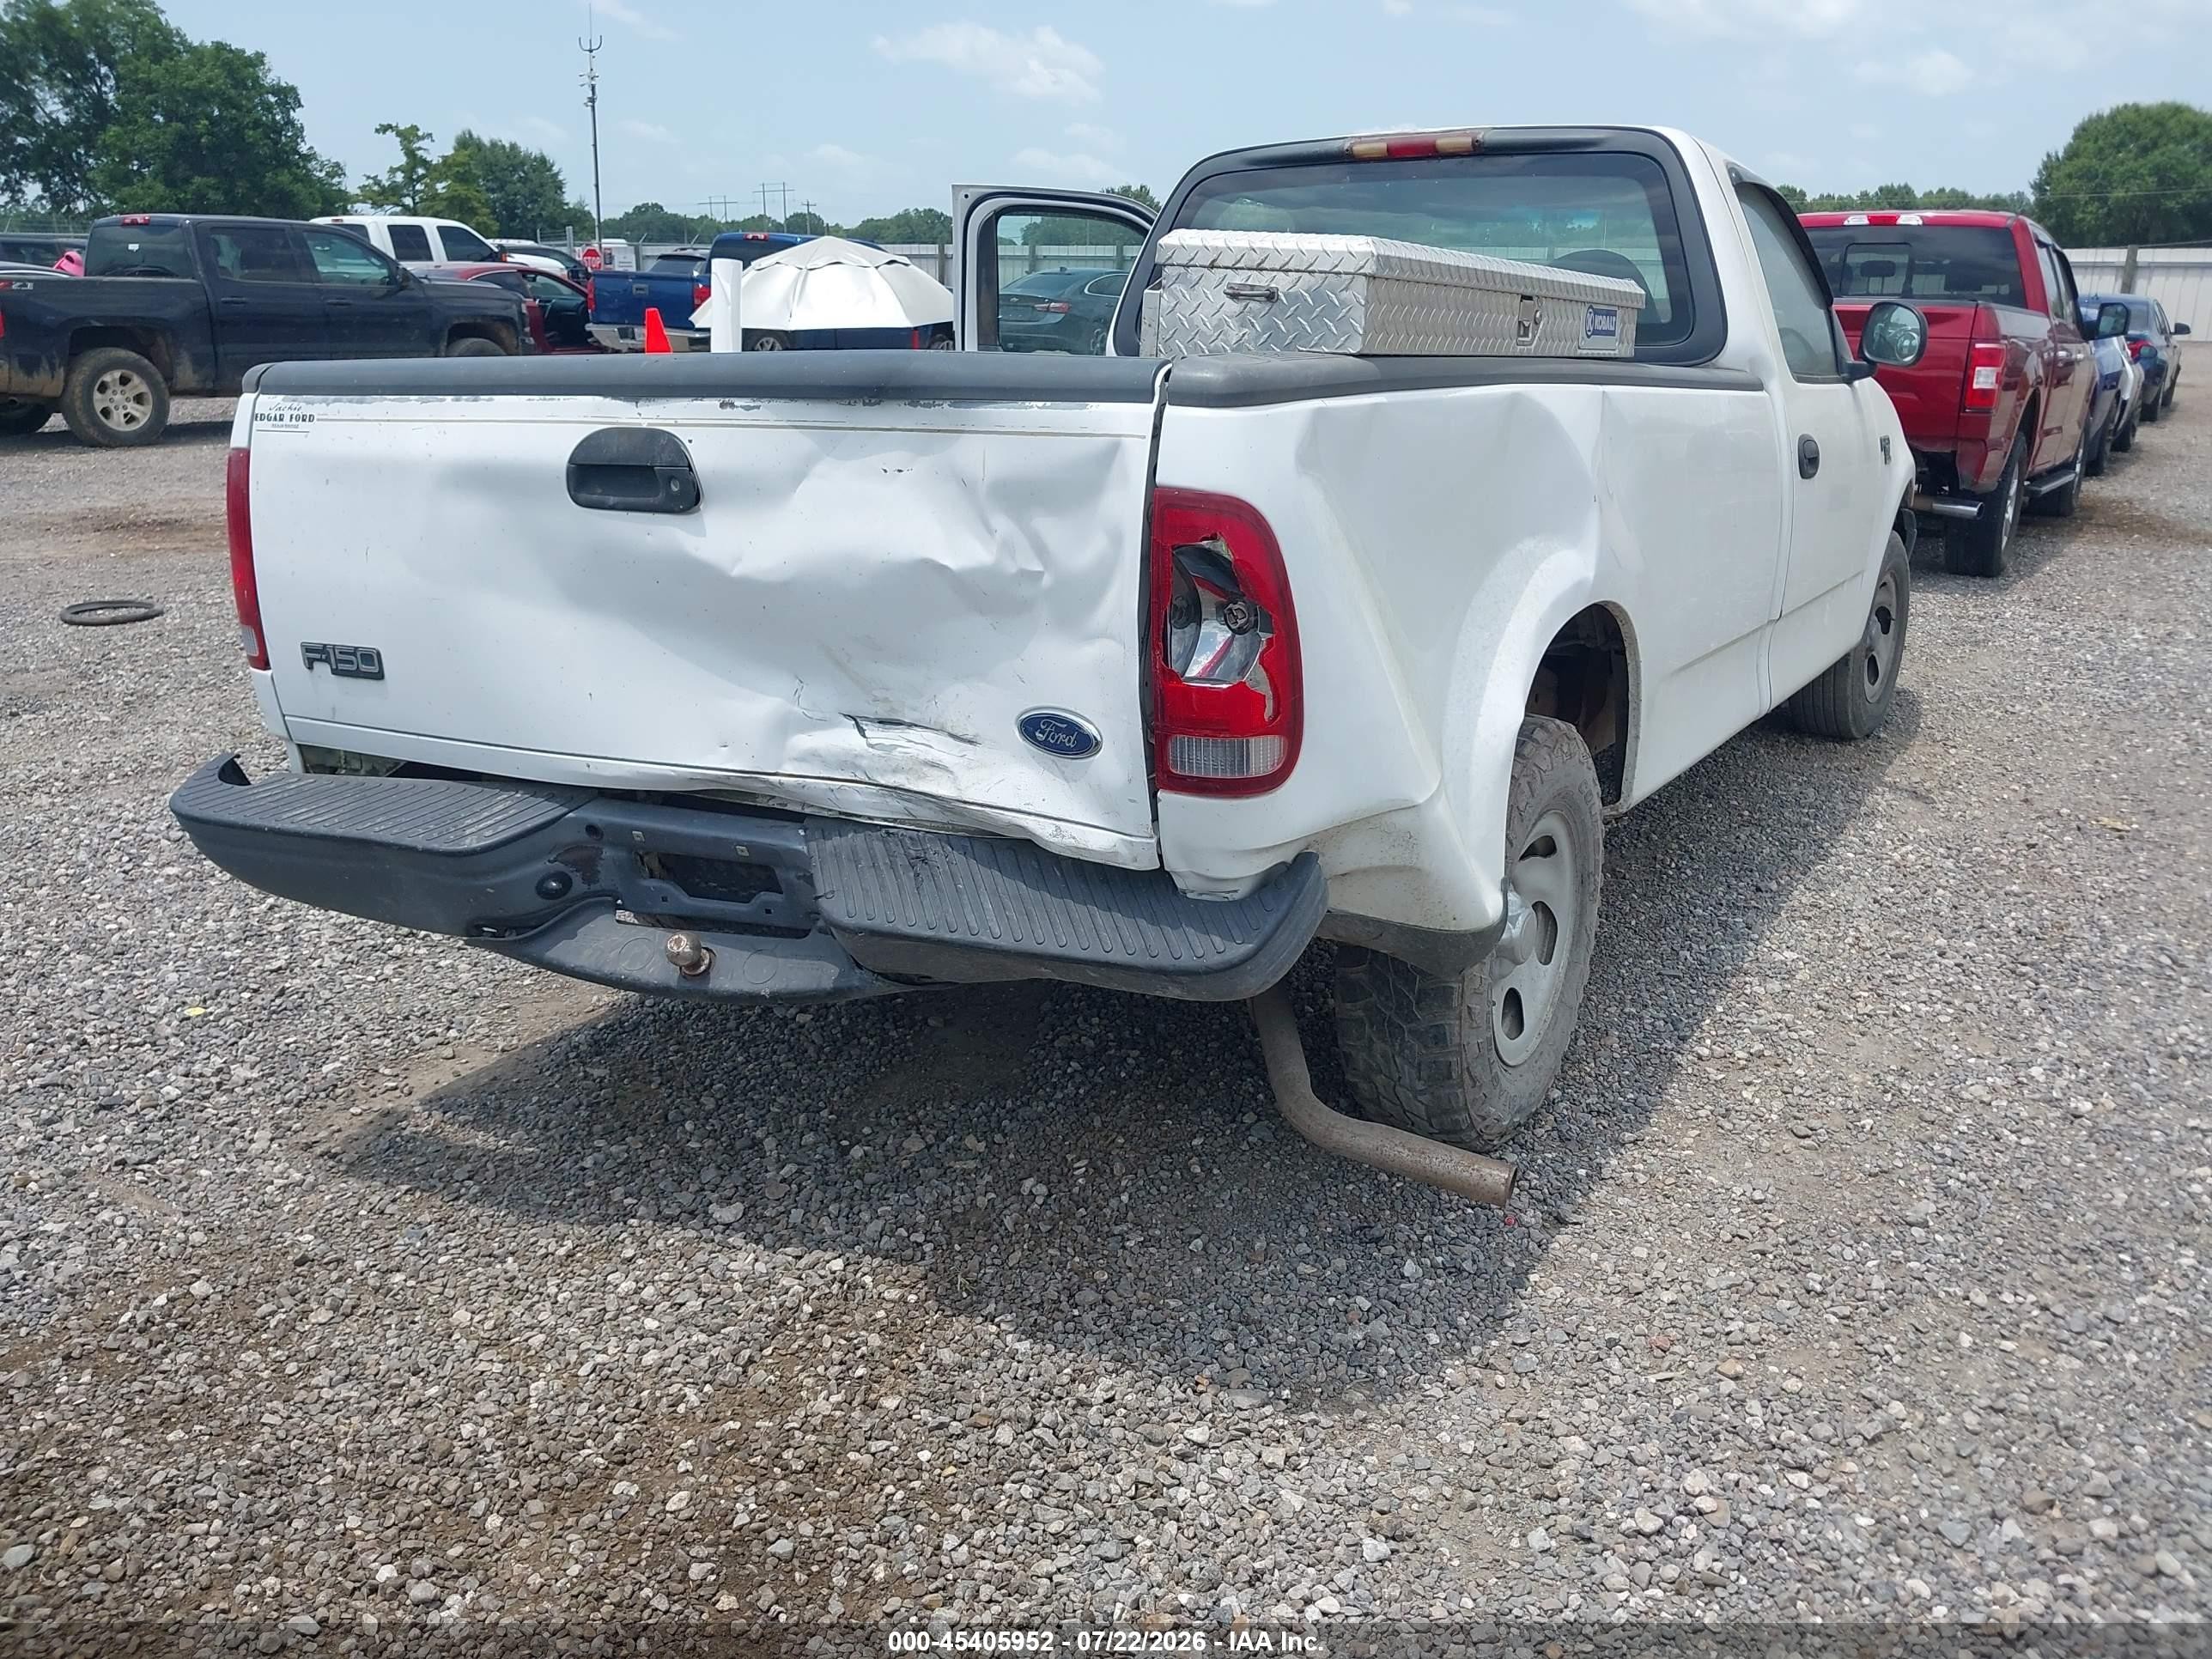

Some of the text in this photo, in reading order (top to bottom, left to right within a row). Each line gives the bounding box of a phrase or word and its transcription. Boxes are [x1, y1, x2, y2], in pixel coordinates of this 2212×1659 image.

[584, 257, 601, 269] STOP
[1594, 315, 1616, 330] KOBALT
[254, 413, 315, 422] EDGAR FORD
[1035, 719, 1079, 748] Ford
